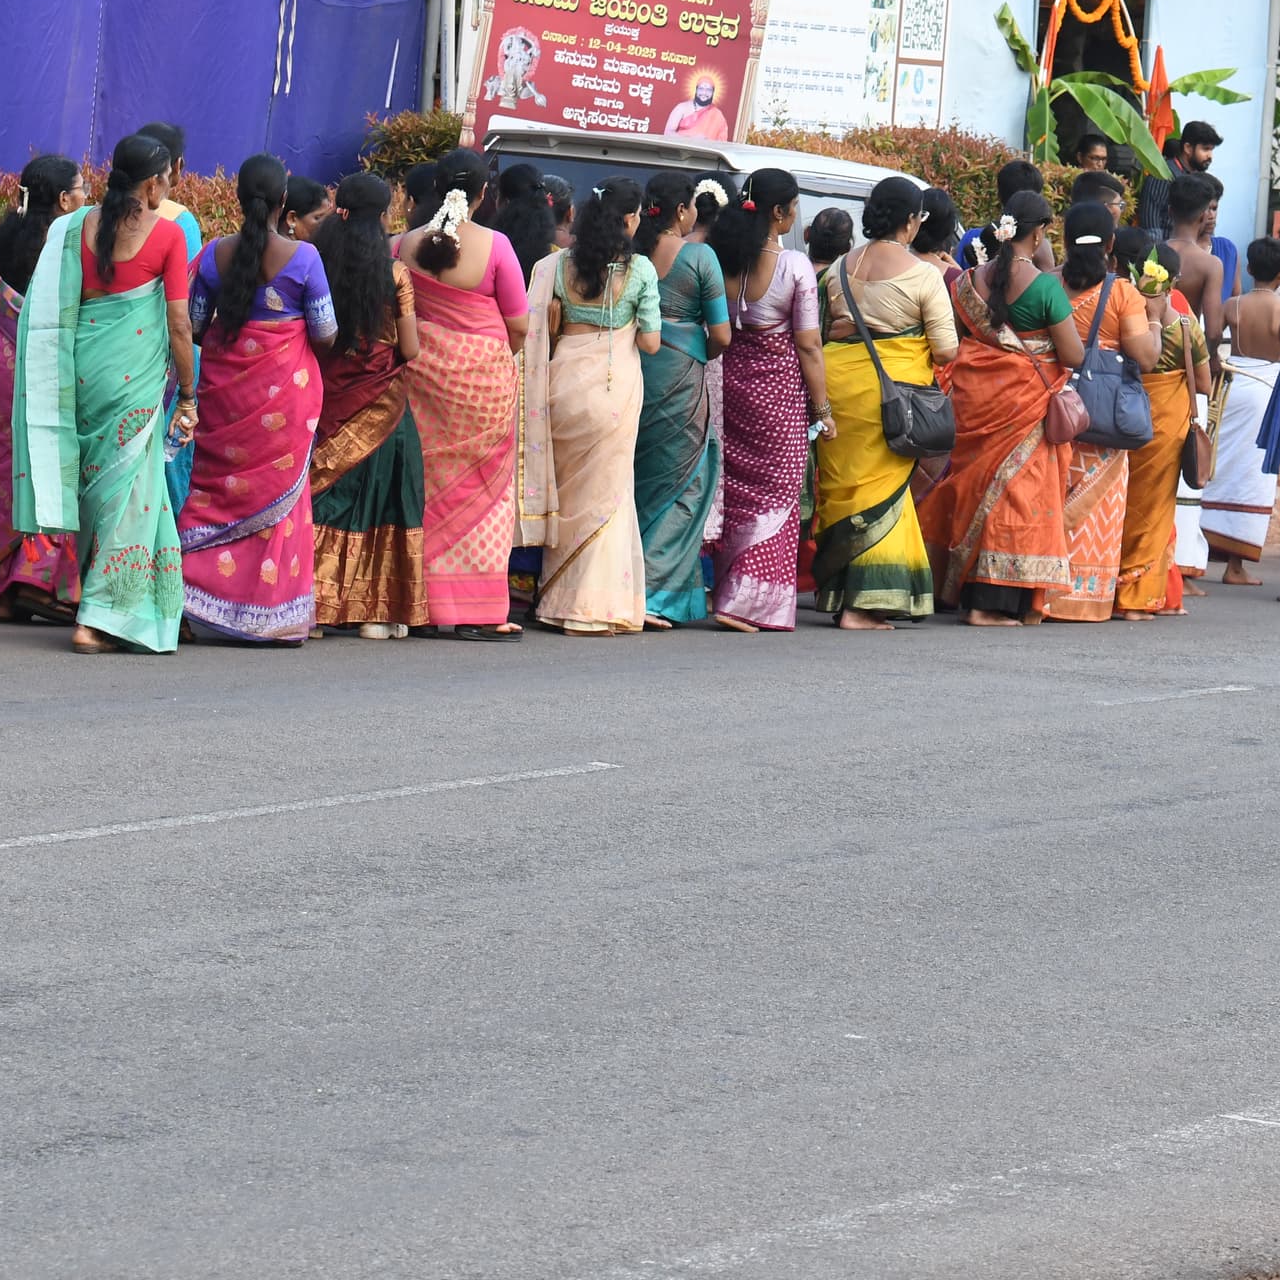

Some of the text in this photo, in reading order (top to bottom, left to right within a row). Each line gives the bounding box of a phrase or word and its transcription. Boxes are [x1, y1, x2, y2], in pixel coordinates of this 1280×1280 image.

[679, 10, 740, 47] ಉತ್ಸವ
[588, 37, 657, 59] 12-04-2025
[554, 49, 597, 69] ಹನುಮ
[572, 73, 620, 94] ಹನುಮ
